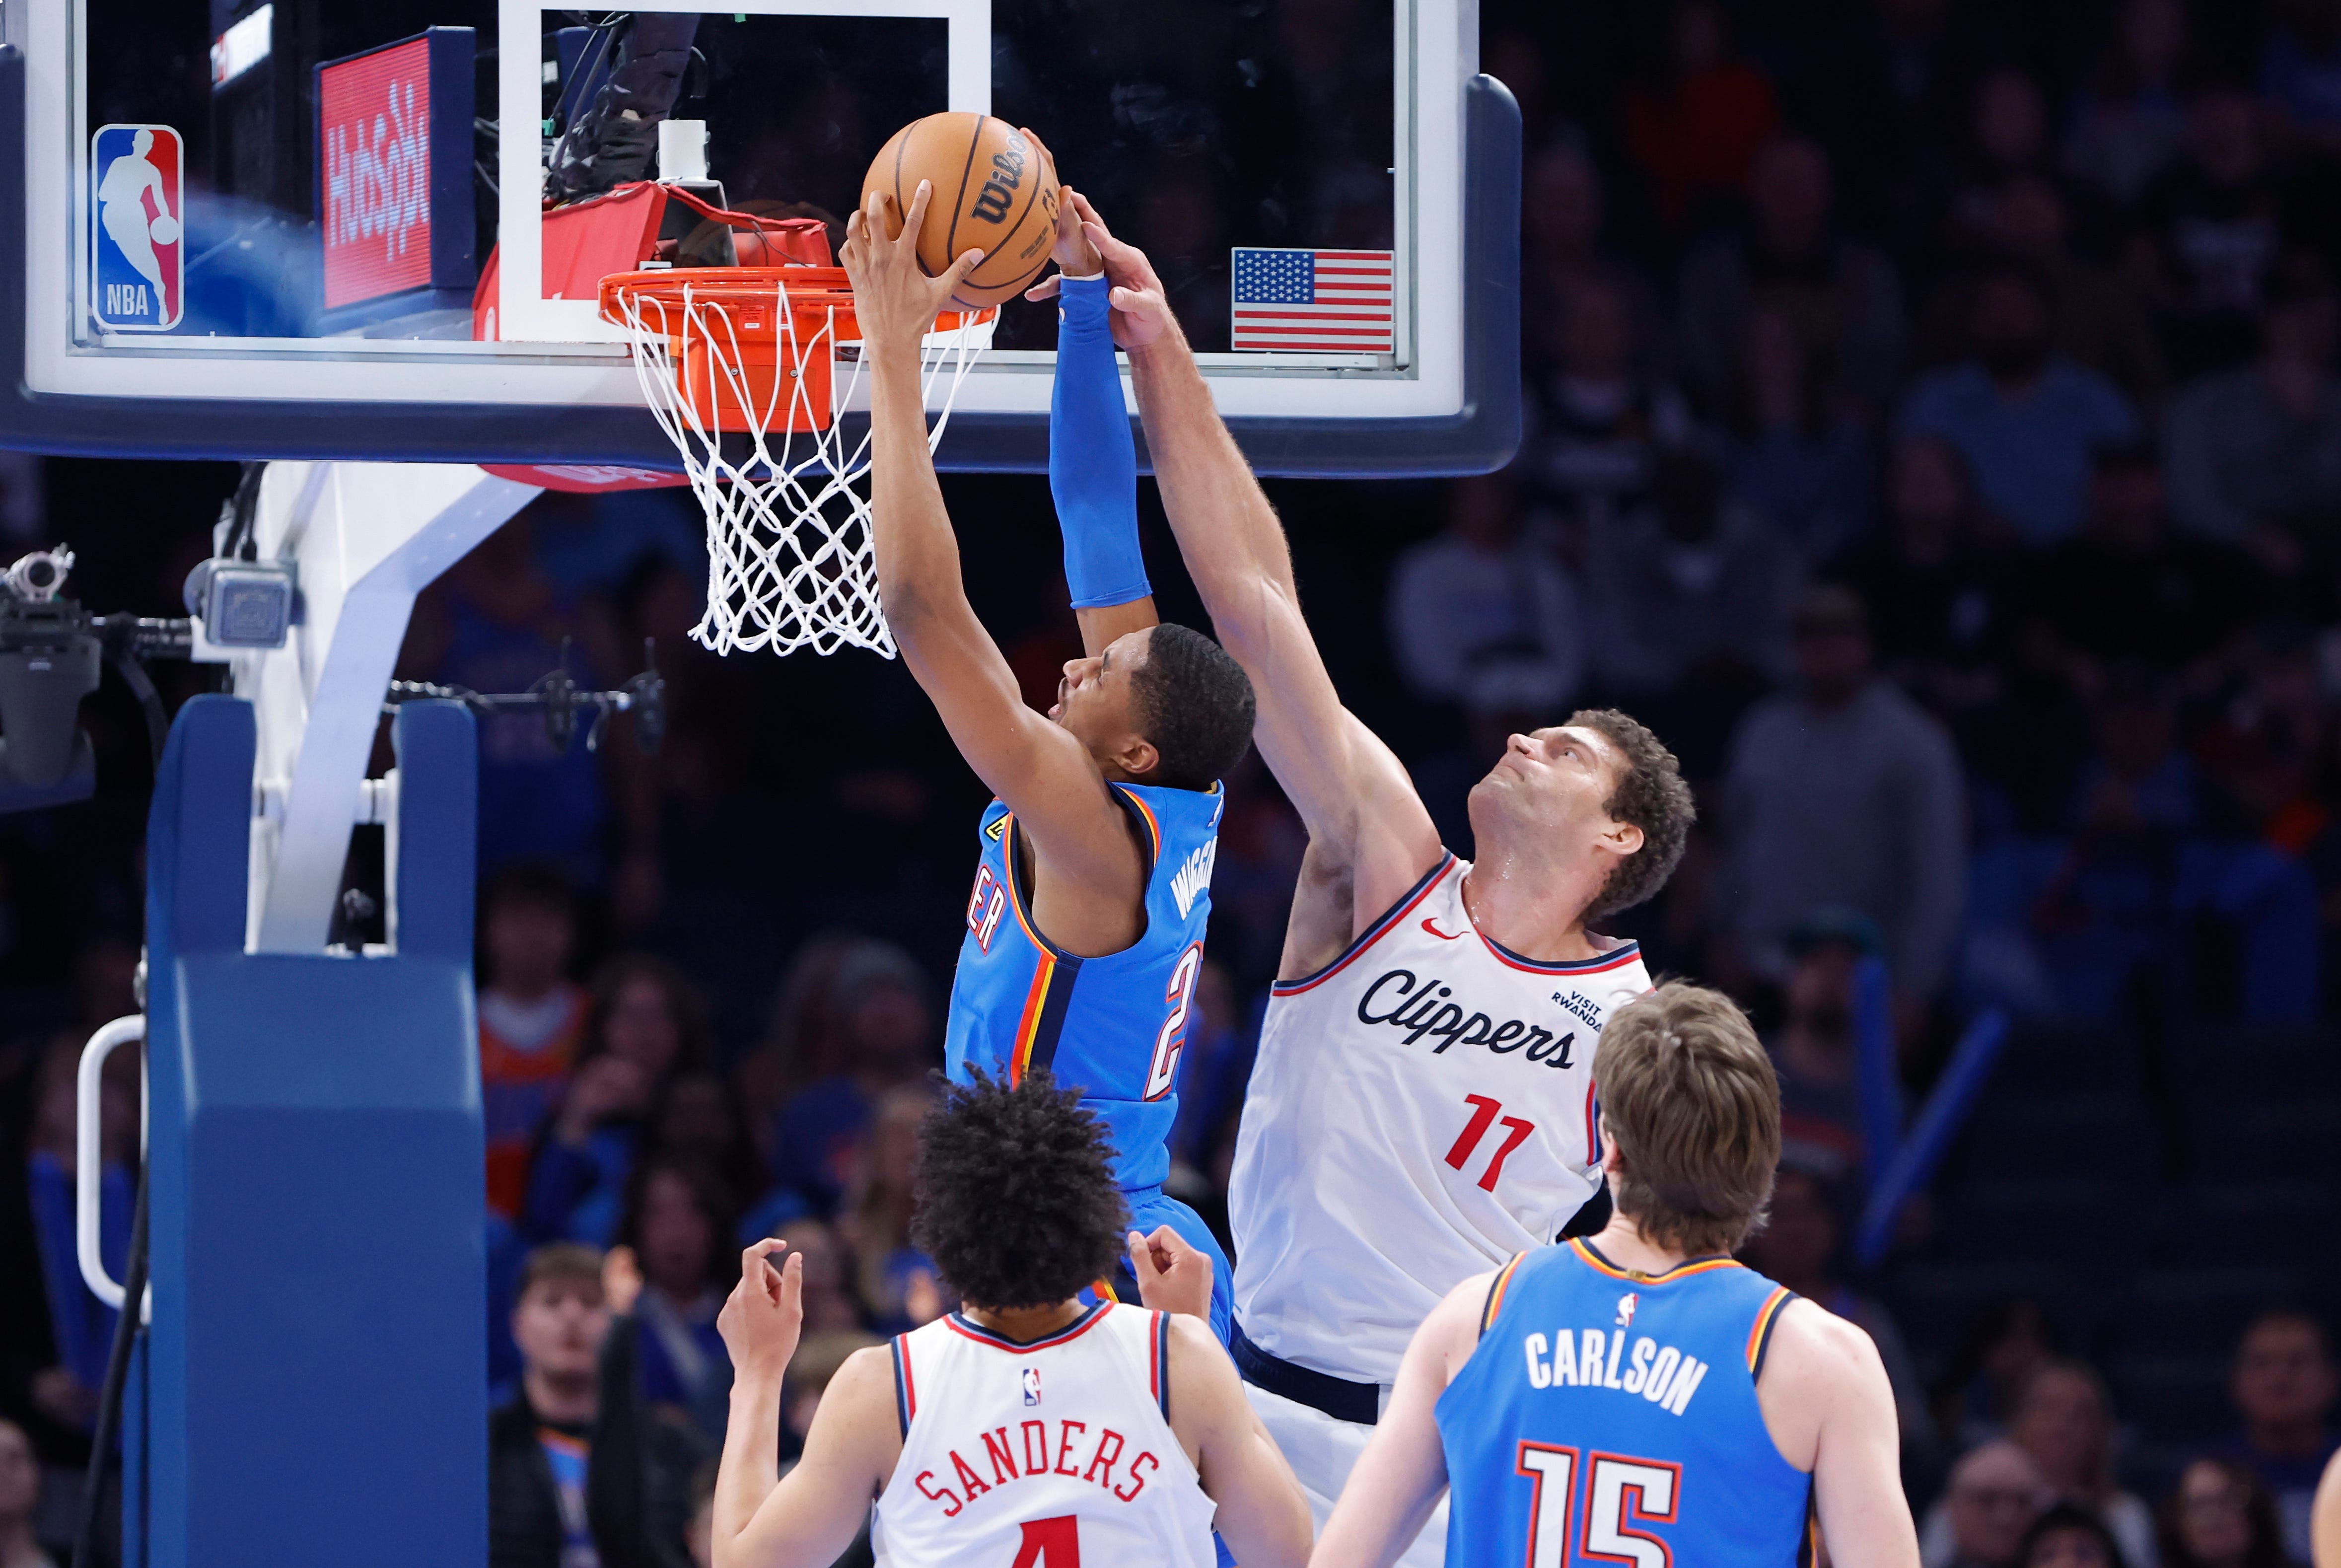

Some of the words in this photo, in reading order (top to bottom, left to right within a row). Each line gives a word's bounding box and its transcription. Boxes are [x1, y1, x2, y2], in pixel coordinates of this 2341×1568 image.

[107, 284, 149, 315] NBA
[1357, 969, 1574, 1069] Clippers
[1551, 992, 1602, 1033] RWANDA
[1571, 990, 1602, 1016] VISIT
[1444, 1093, 1535, 1193] 11
[1524, 1329, 1709, 1417] CARLSON
[915, 1420, 1159, 1517] SANDERS
[1516, 1438, 1683, 1568] 15
